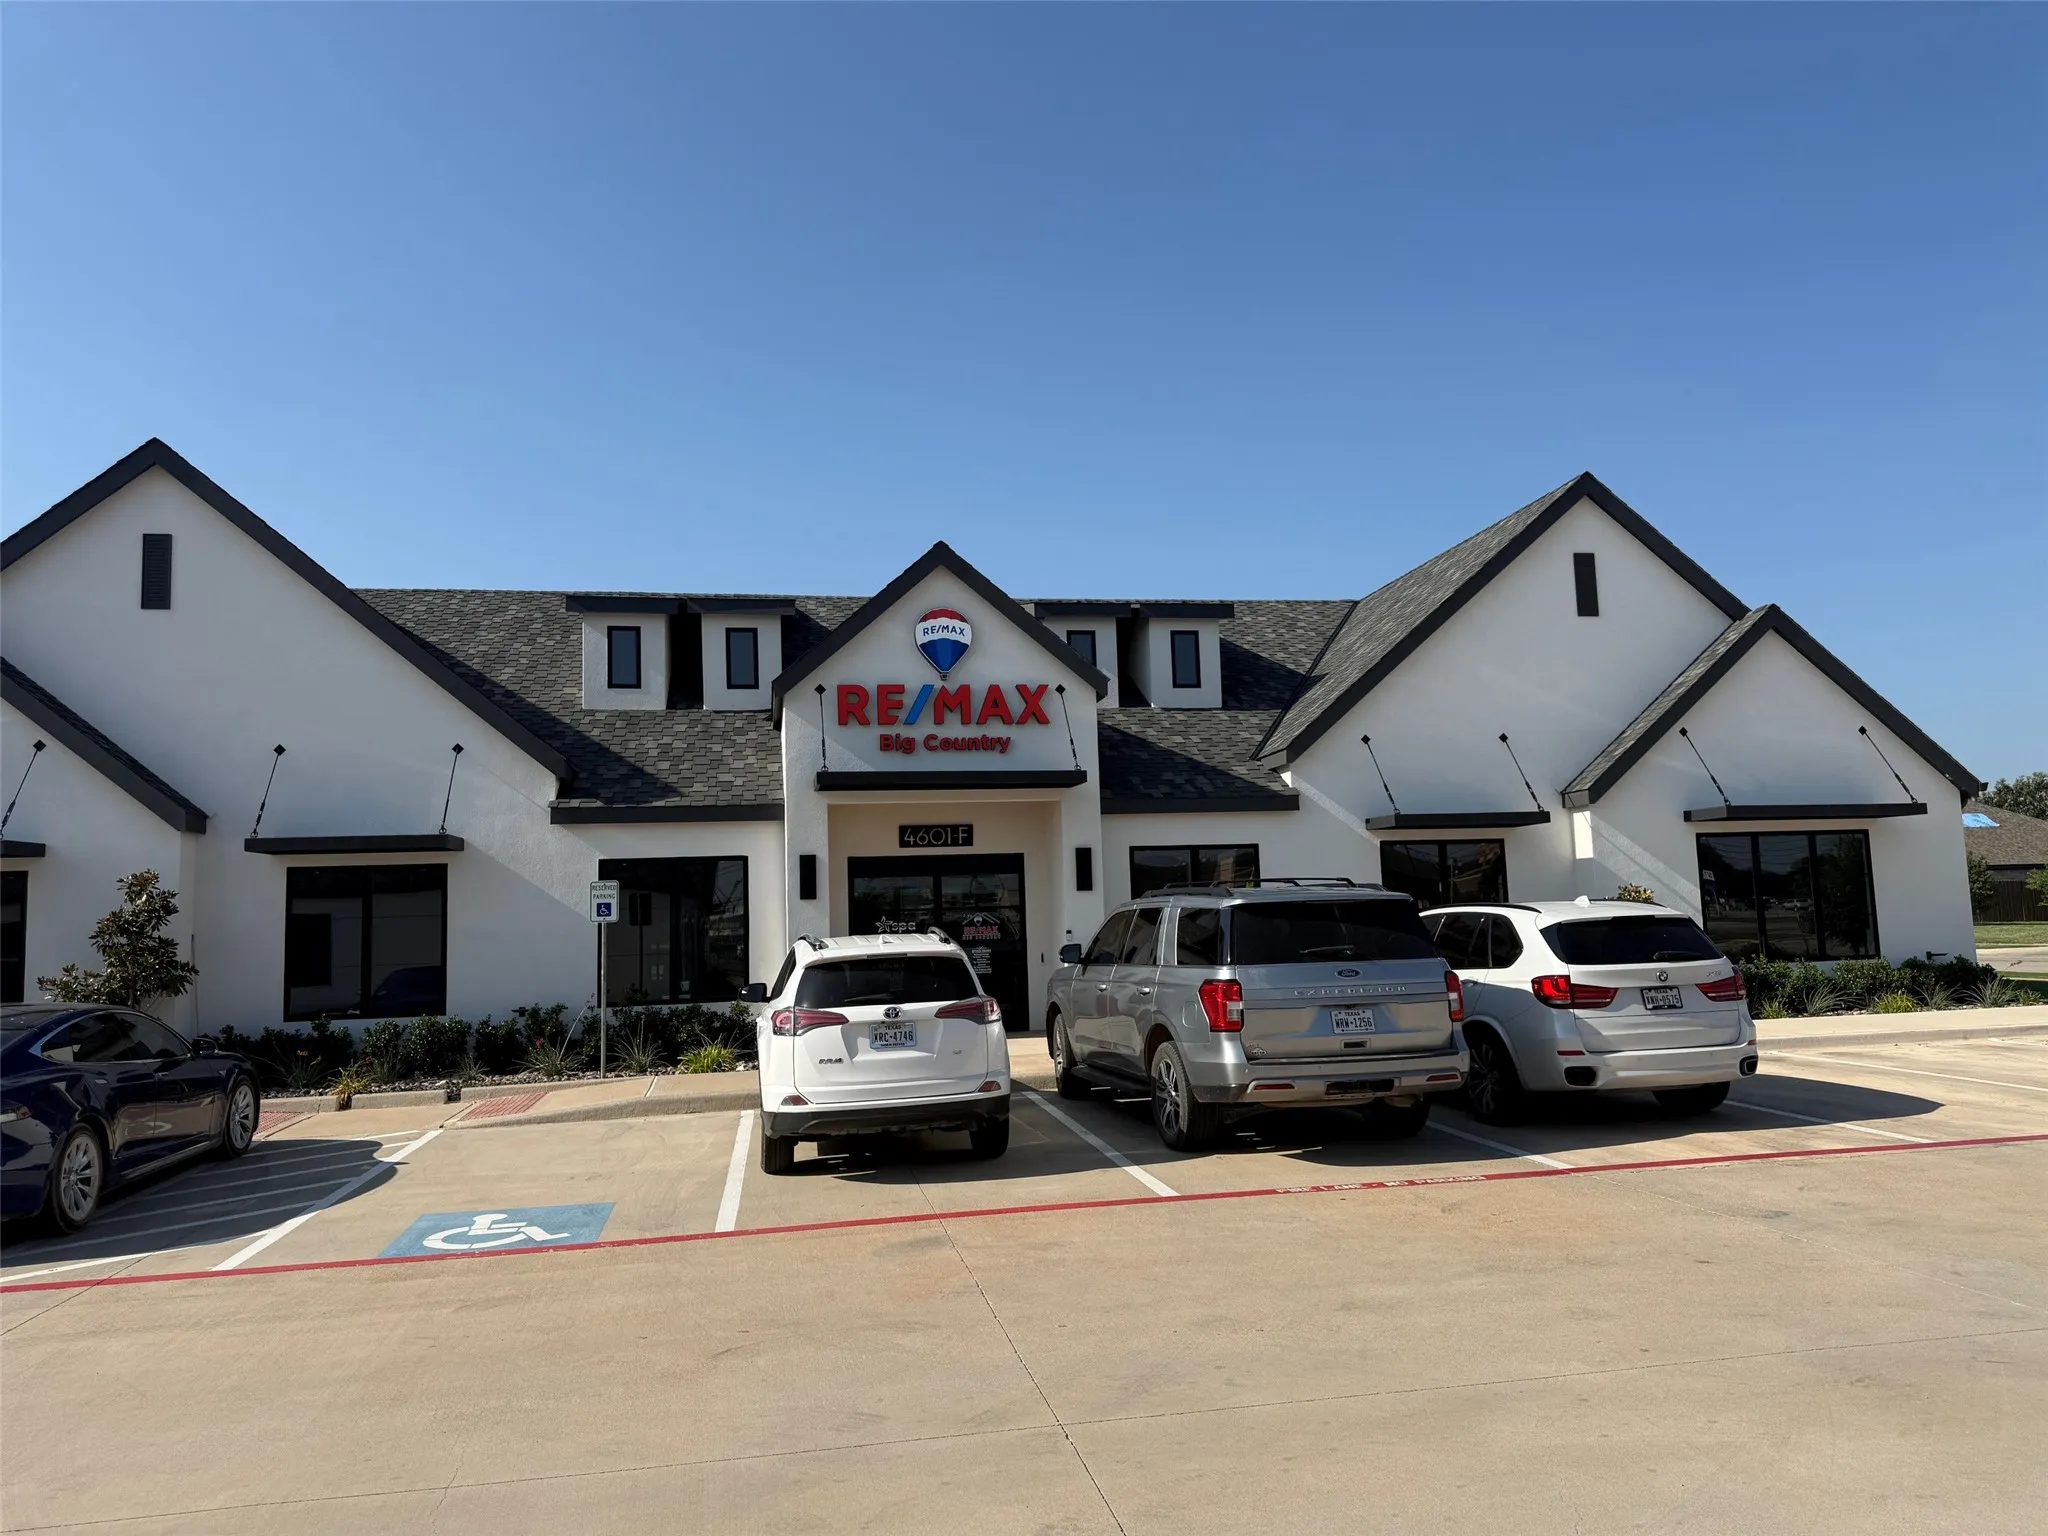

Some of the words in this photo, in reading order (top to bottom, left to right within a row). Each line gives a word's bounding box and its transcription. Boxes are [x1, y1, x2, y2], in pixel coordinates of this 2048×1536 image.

[922, 624, 966, 637] RE/MAX
[836, 684, 1050, 726] RE/MAX
[879, 733, 916, 754] Big
[923, 733, 1011, 754] Country
[904, 826, 969, 845] 4601-F
